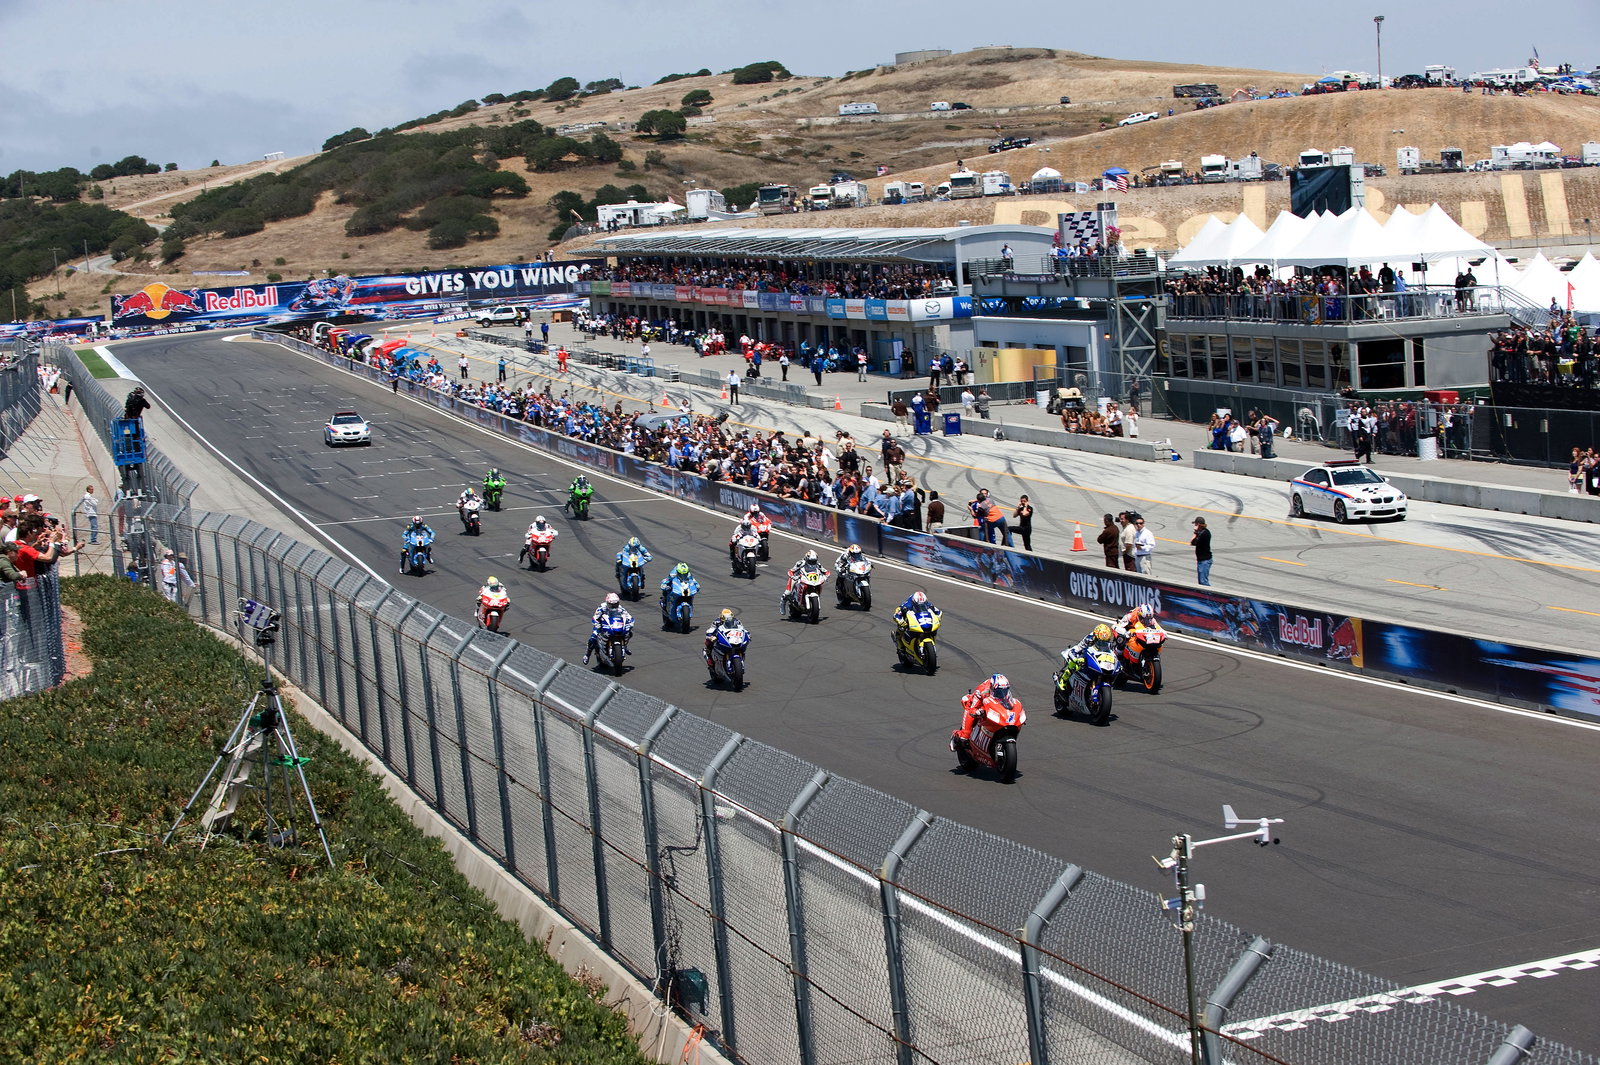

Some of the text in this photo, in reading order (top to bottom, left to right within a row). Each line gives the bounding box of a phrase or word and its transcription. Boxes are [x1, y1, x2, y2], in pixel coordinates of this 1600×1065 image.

[405, 273, 466, 296] GIVES
[469, 269, 515, 290] YOU
[204, 285, 279, 312] Red Bull
[437, 314, 456, 322] GIVES
[1069, 571, 1162, 615] GIVES YOU WINGS
[1278, 612, 1323, 649] Red Bull
